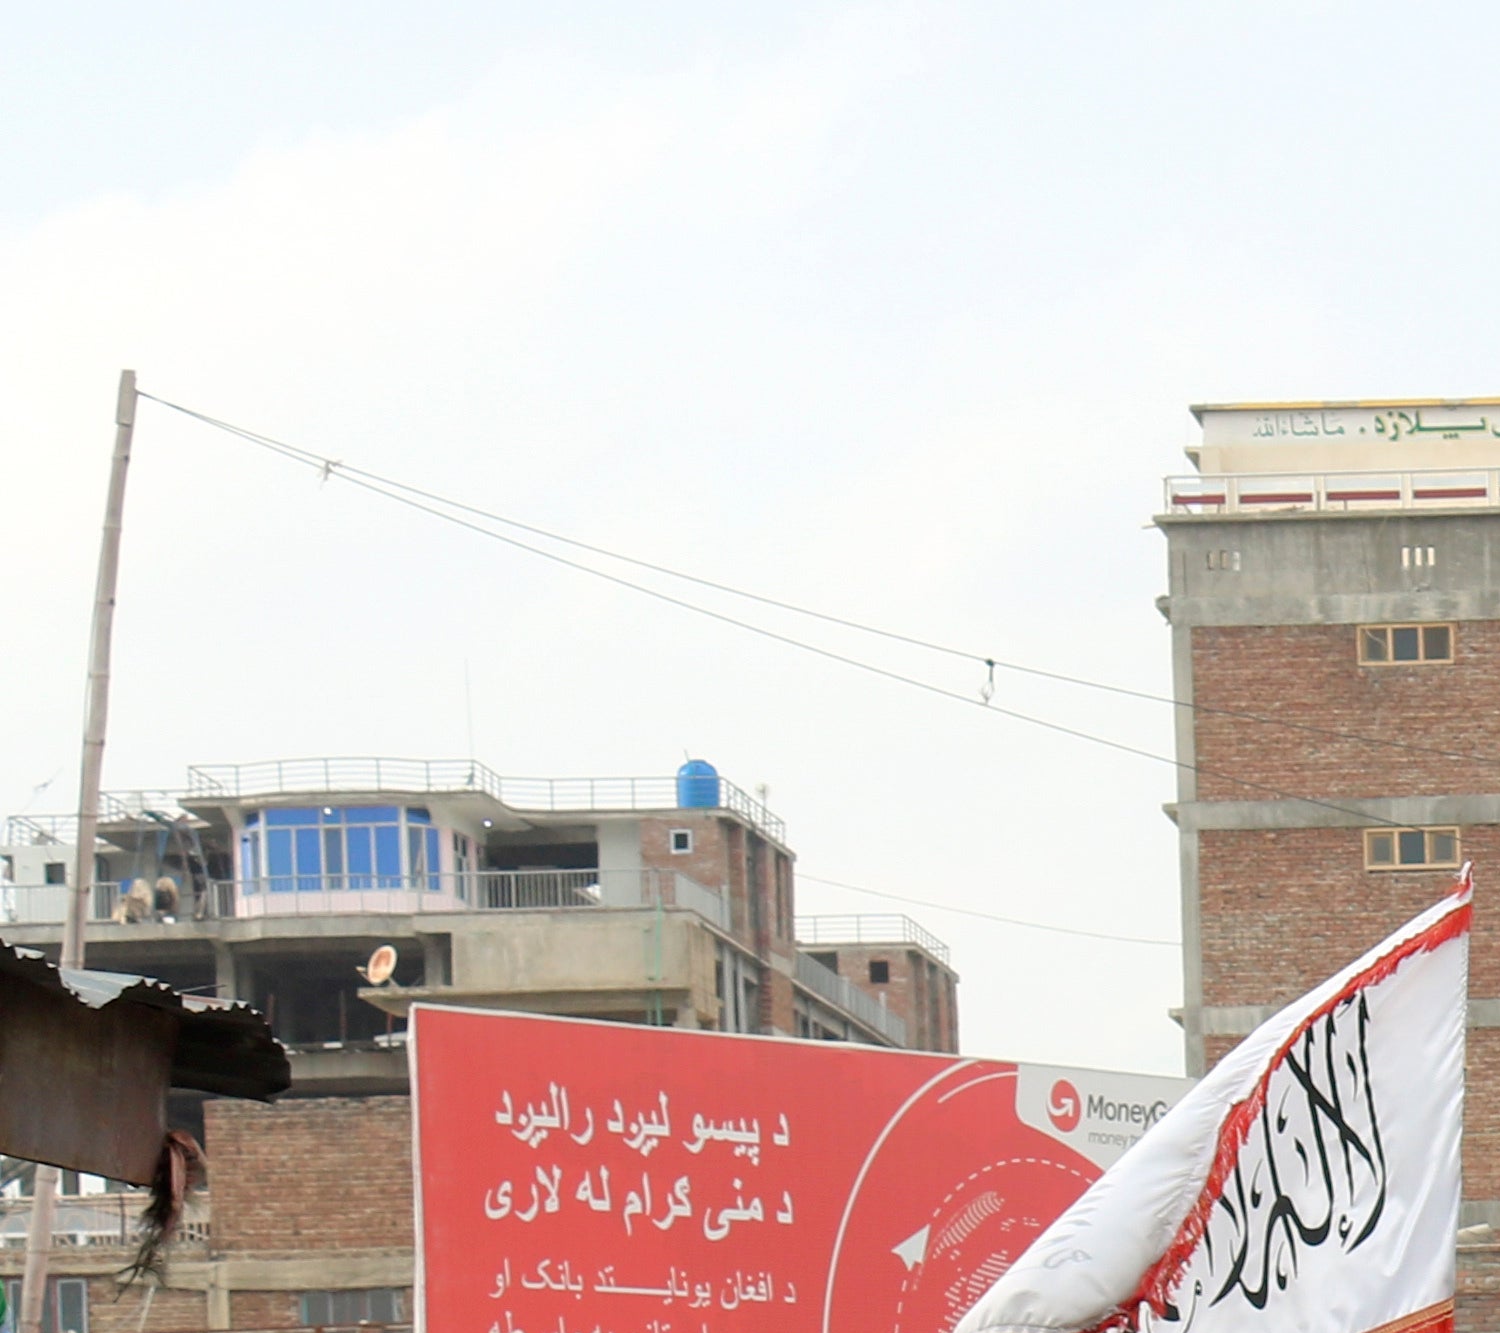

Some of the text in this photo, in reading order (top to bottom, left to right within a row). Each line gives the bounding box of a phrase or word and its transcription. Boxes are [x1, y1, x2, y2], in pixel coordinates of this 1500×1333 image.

[772, 1113, 790, 1147] د
[1086, 1094, 1169, 1130] MoneyG
[575, 1165, 612, 1212] له
[776, 1191, 794, 1225] د
[488, 1257, 511, 1298] او
[720, 1269, 774, 1310] افغان
[783, 1281, 797, 1304] د
